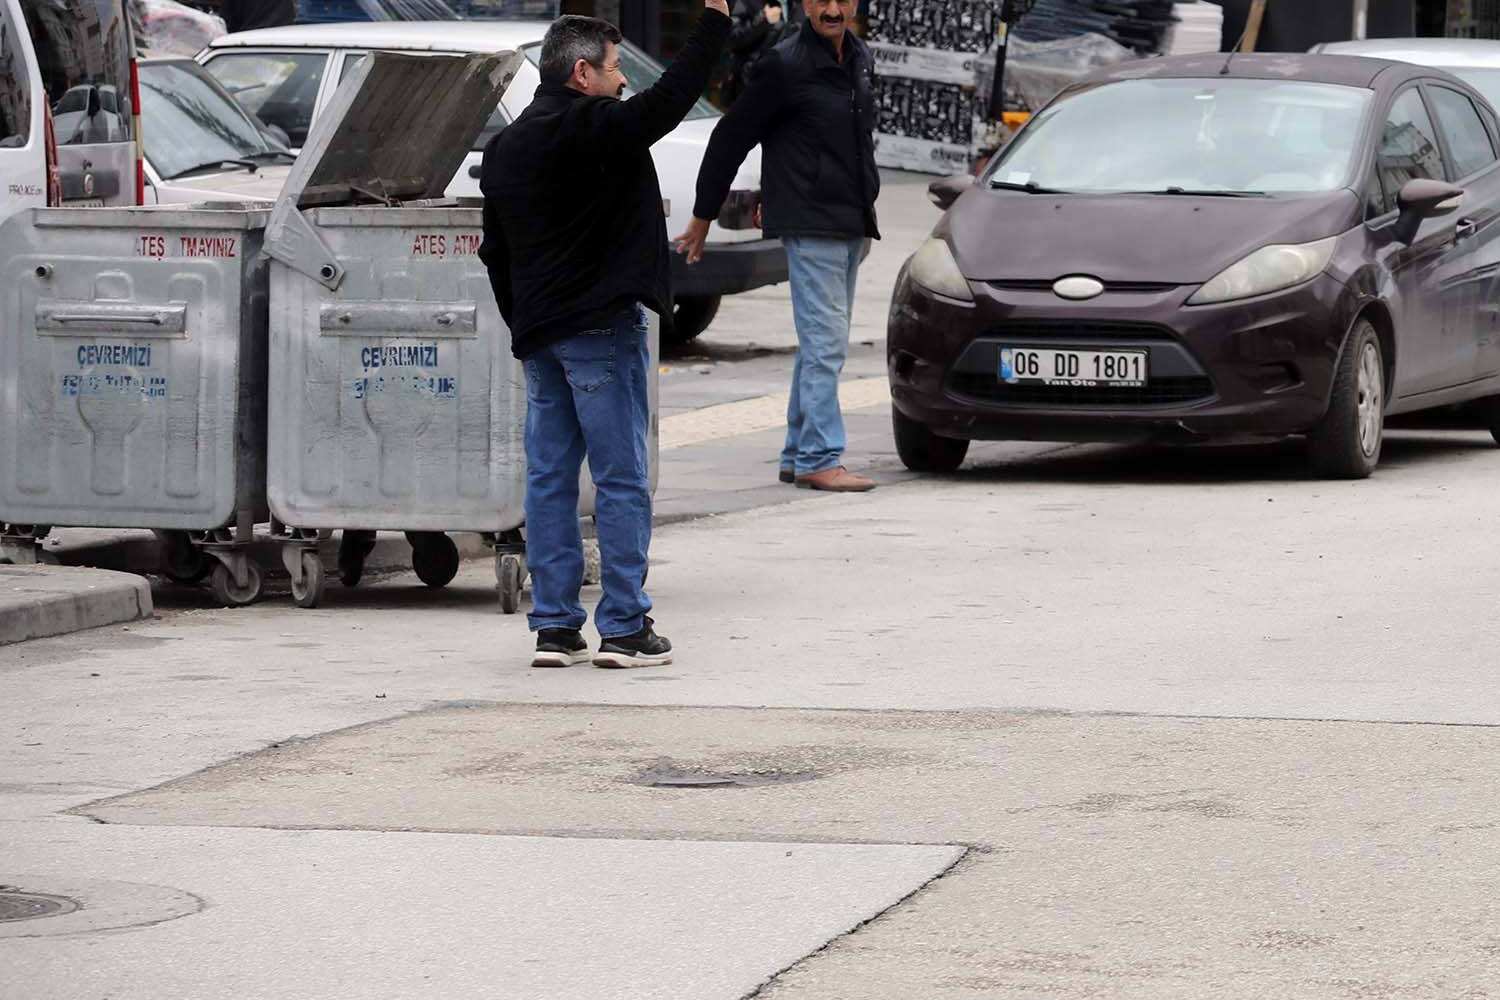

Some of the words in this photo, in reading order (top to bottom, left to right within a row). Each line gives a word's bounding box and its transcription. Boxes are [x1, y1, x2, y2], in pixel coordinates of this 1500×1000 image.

[413, 235, 446, 260] ATEŞ
[77, 343, 151, 370] ÇEVREMİZİ
[1015, 352, 1039, 376] 06
[1055, 353, 1079, 377] DD
[1093, 355, 1140, 379] 1801
